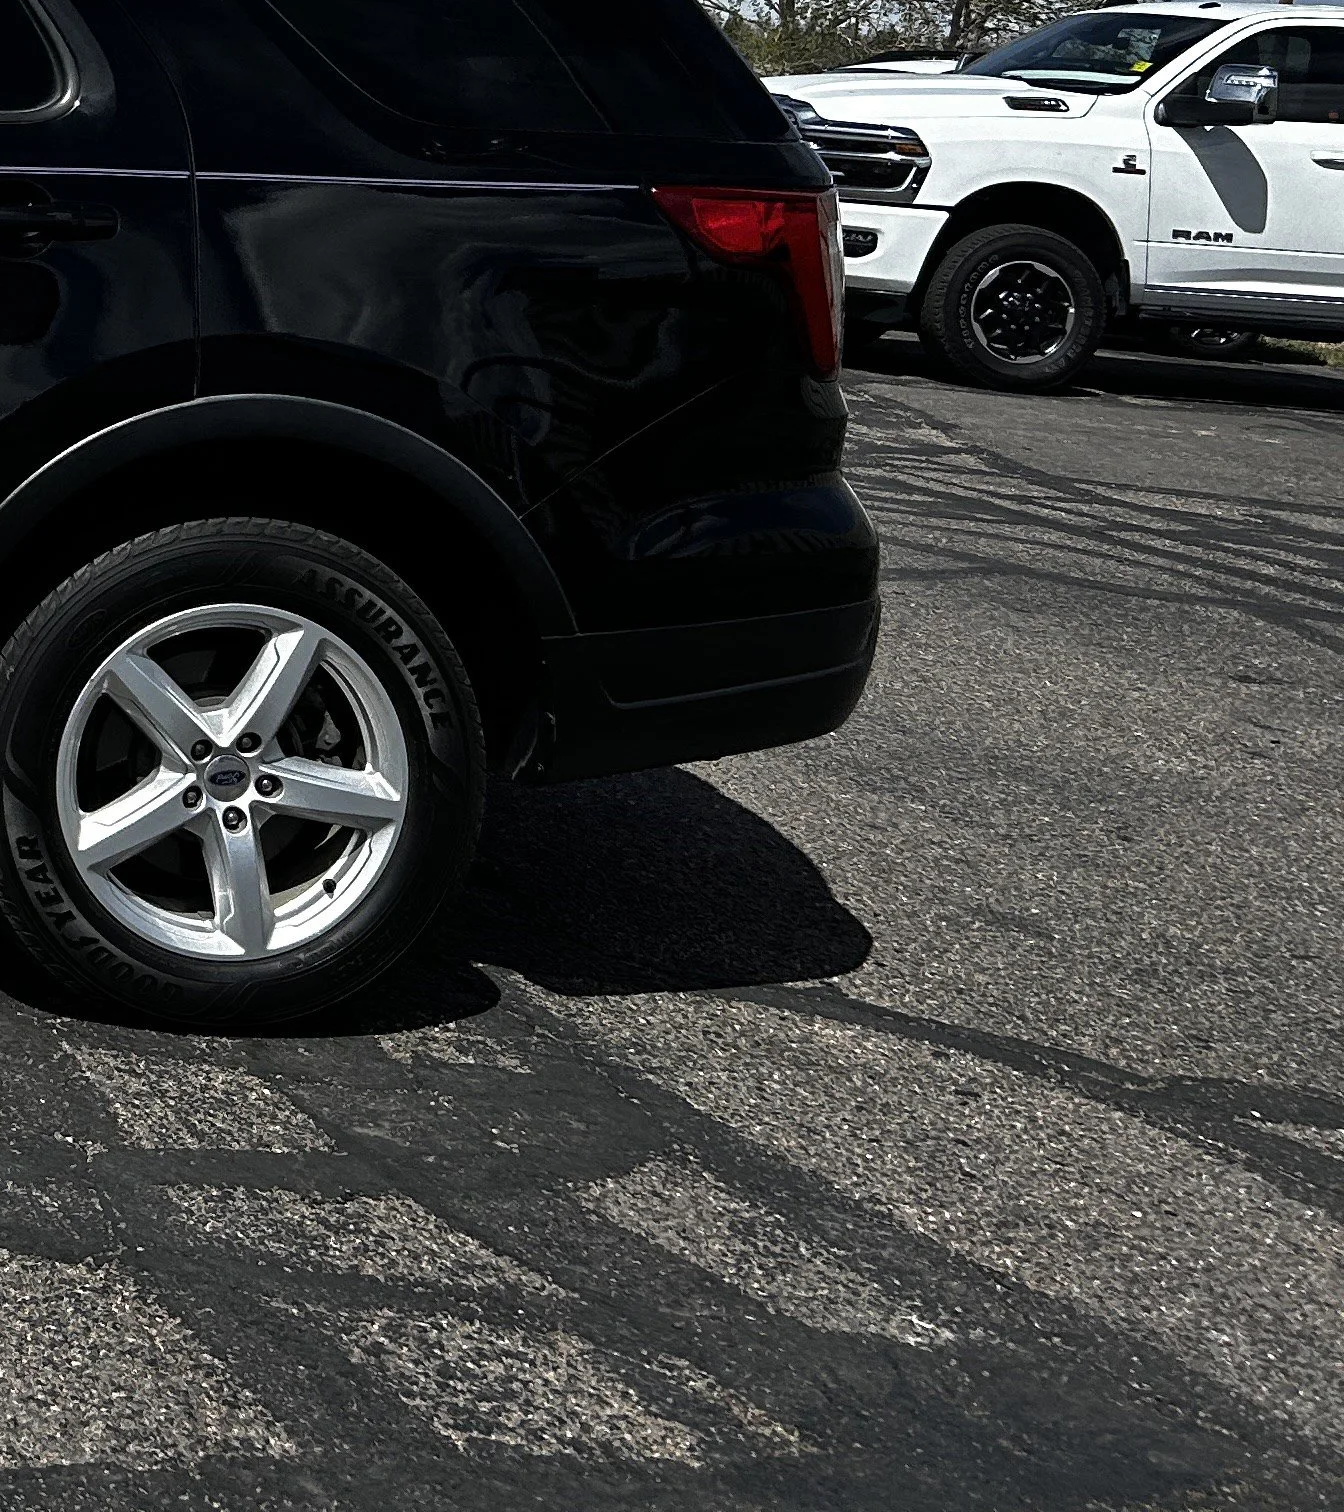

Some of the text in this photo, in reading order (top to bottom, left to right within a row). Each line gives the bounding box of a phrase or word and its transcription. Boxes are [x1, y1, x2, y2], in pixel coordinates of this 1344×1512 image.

[1172, 229, 1233, 243] RAM
[293, 568, 452, 731] ASSURANCE
[16, 834, 184, 997] GOODYEAR
